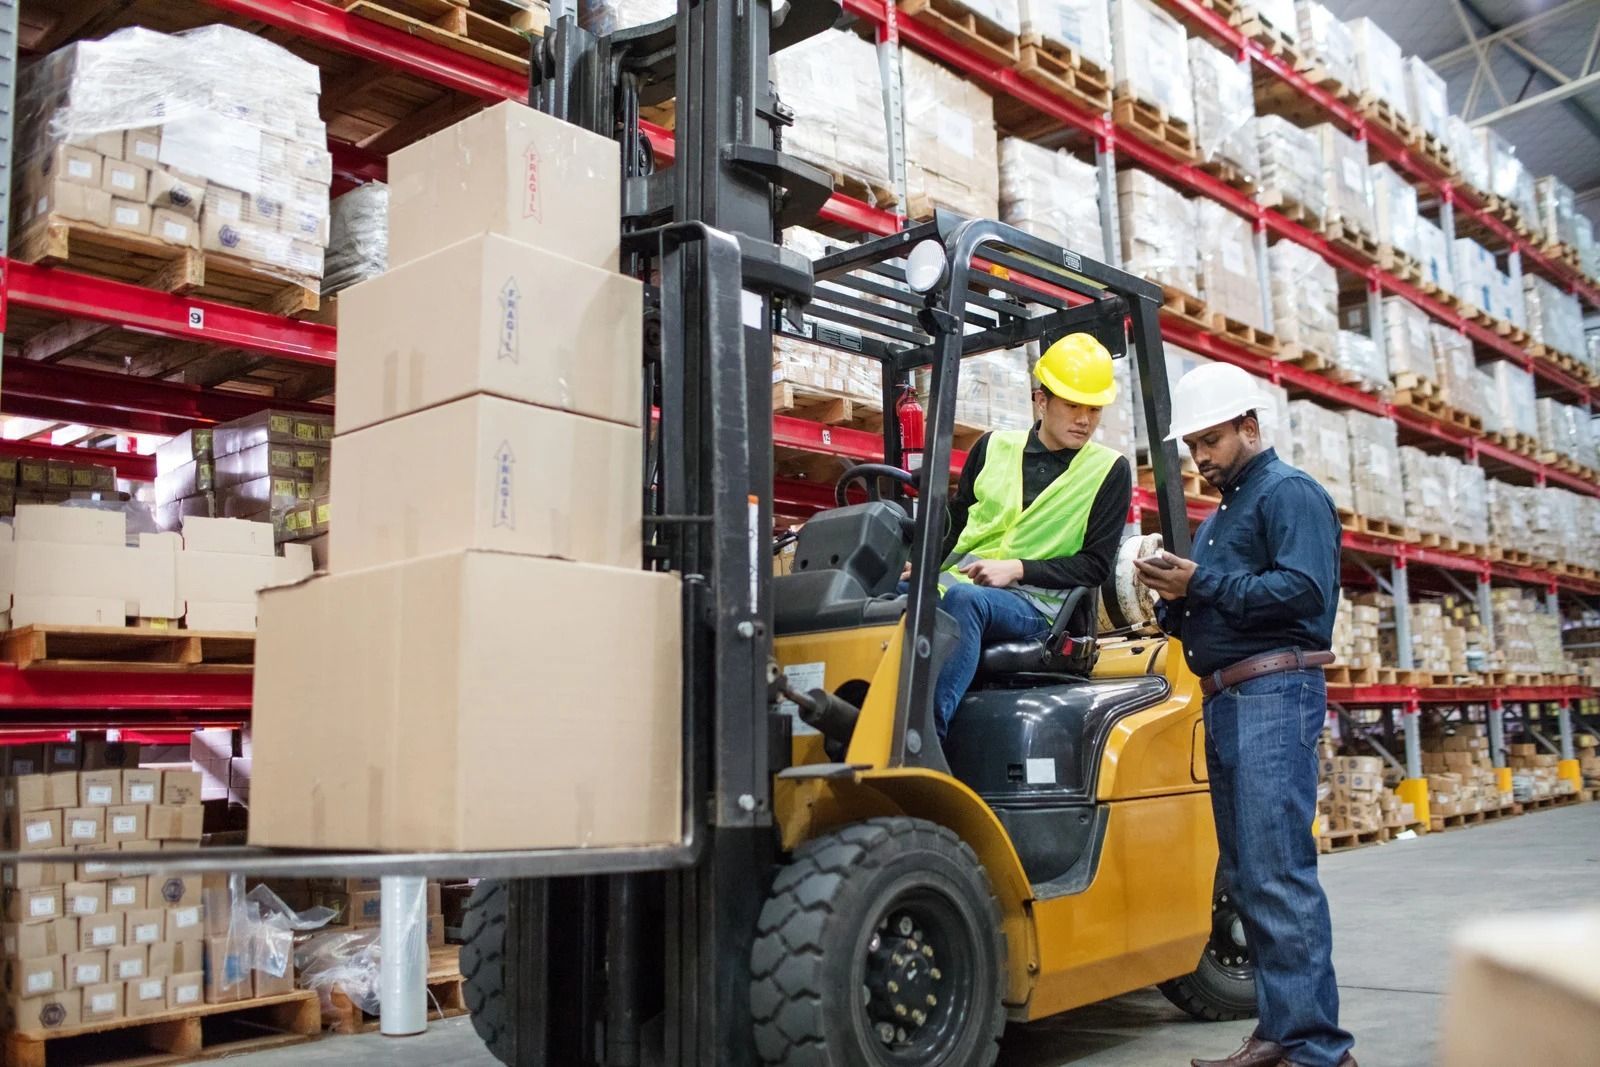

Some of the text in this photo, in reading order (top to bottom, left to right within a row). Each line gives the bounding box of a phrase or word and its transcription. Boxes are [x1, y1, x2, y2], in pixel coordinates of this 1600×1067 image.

[528, 153, 538, 213] FRAGIL
[190, 312, 202, 324] 9
[505, 288, 516, 353] FRAGIL
